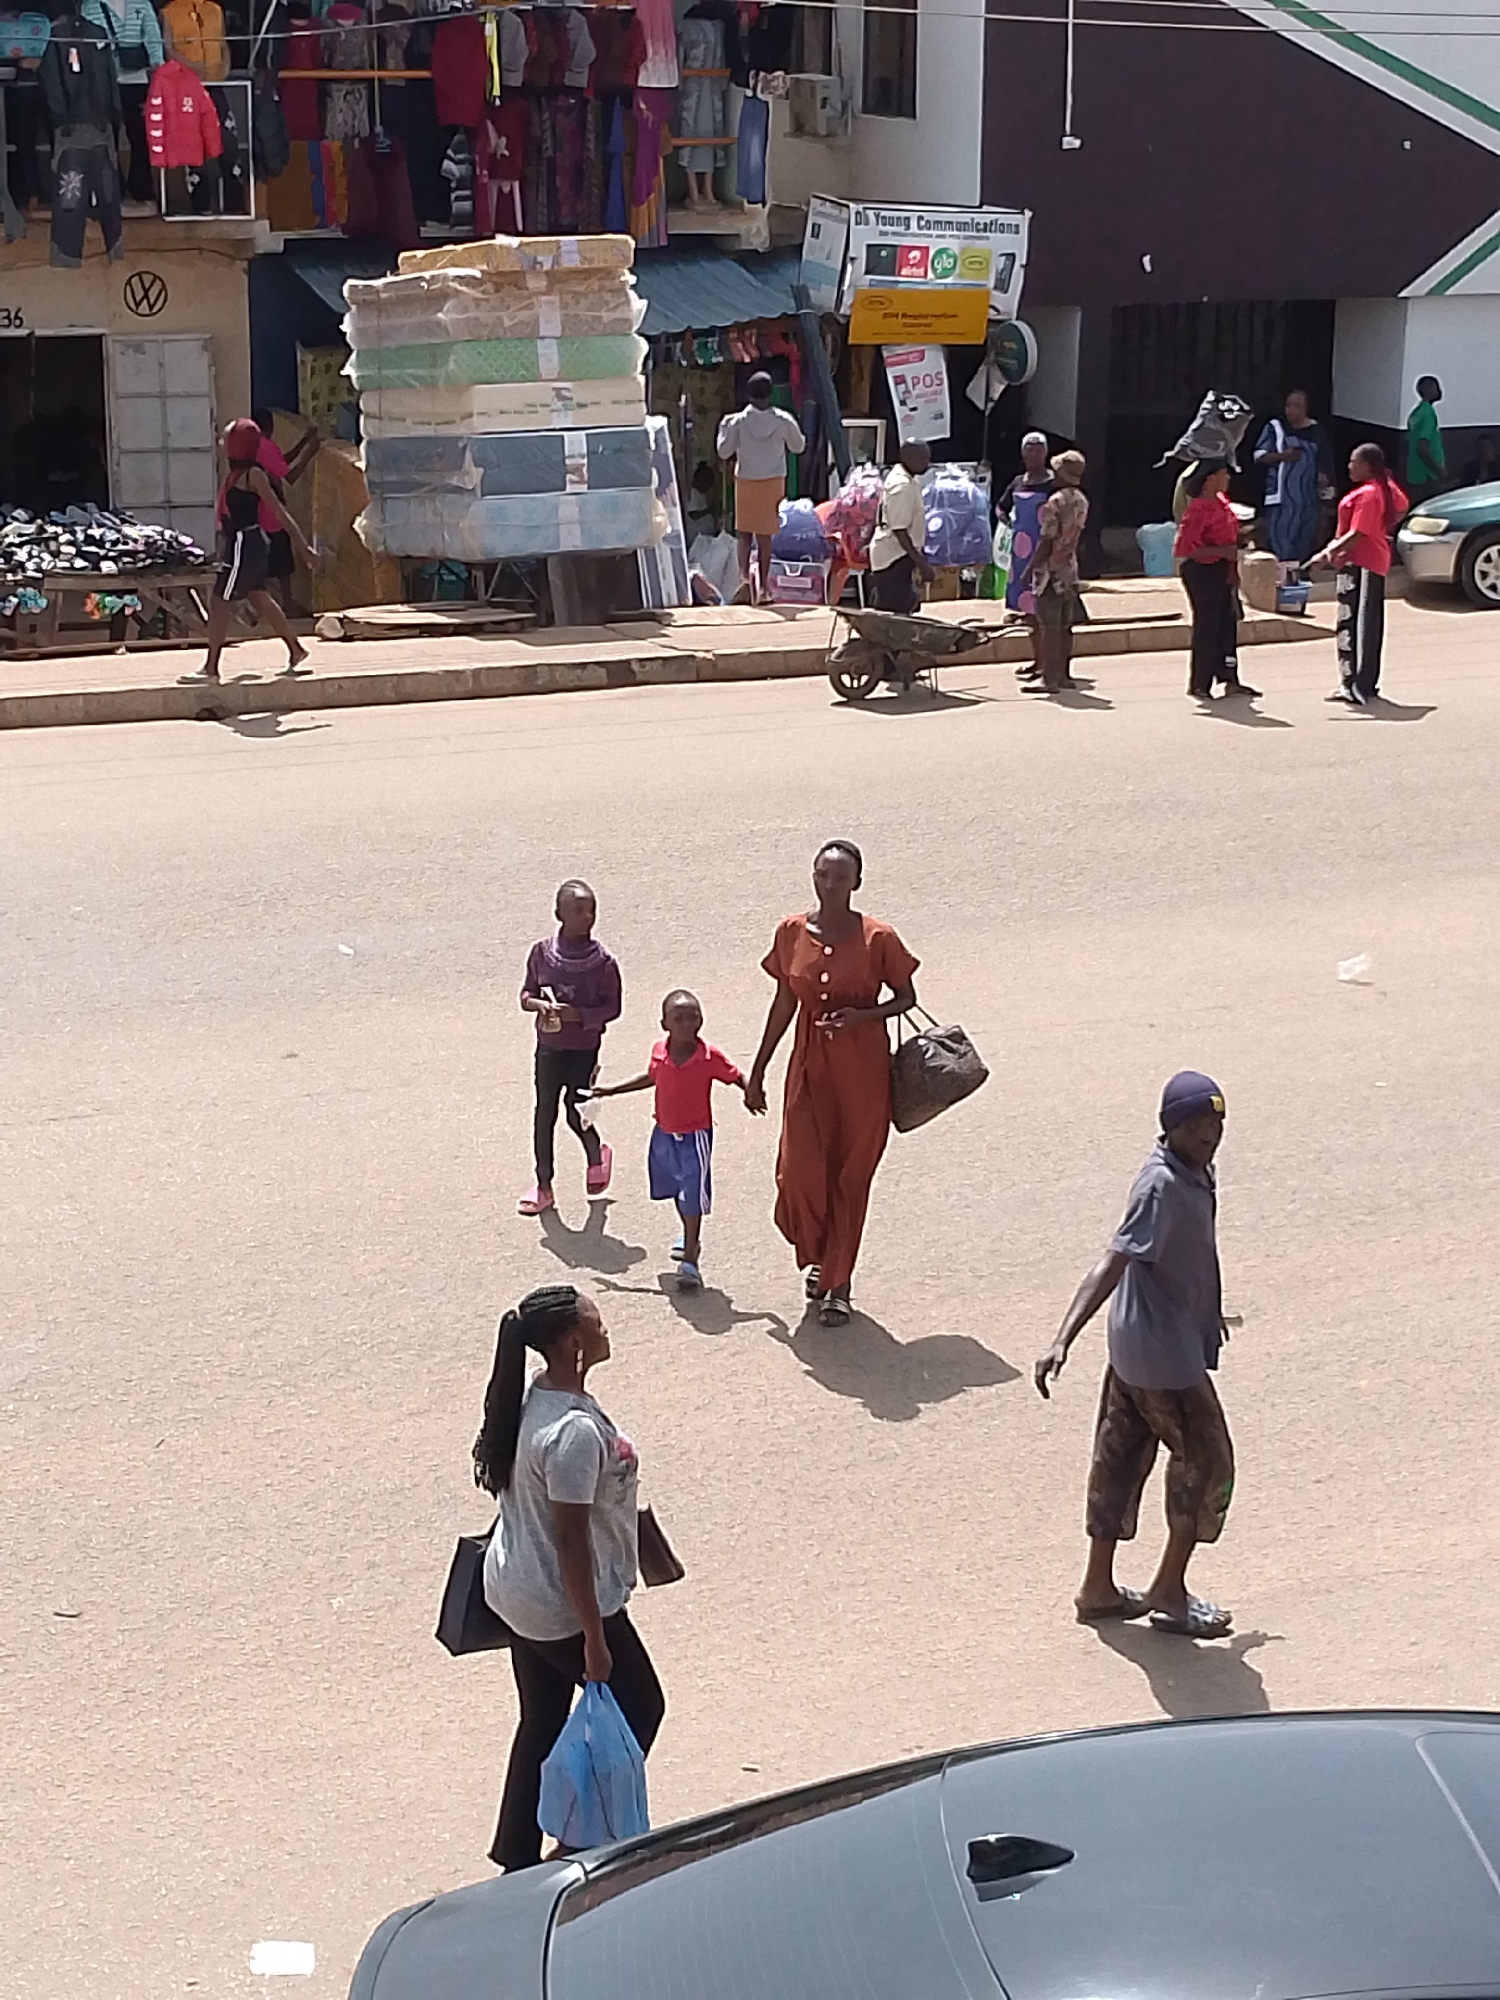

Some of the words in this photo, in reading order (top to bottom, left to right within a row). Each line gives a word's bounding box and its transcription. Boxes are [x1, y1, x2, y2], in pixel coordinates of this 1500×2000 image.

[873, 211, 911, 231] Young
[917, 214, 1021, 236] Communications
[933, 254, 953, 274] glo
[911, 371, 944, 391] POS
